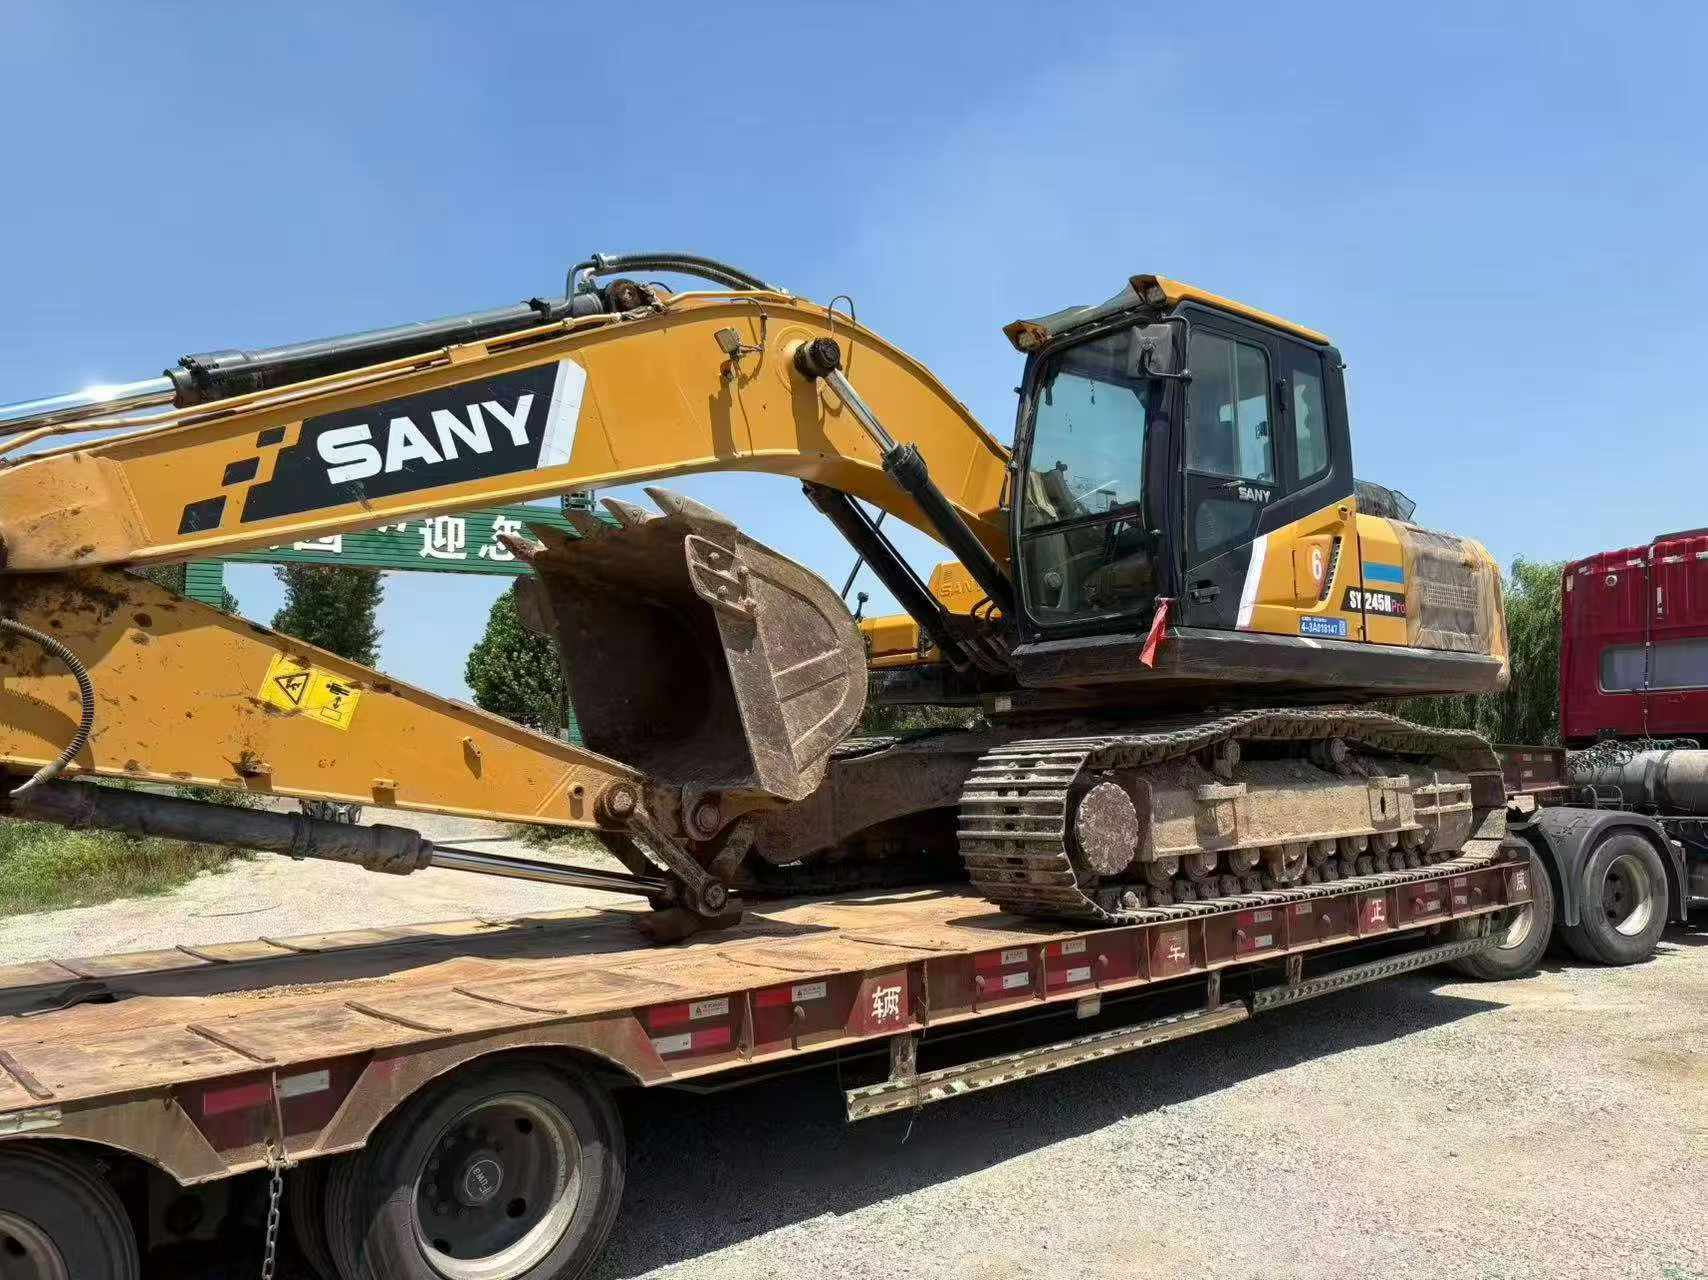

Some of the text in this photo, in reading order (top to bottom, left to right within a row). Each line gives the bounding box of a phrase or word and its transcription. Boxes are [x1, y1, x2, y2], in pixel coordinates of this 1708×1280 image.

[317, 394, 535, 485] SANY
[1238, 487, 1271, 503] SANY
[1312, 545, 1322, 580] 6
[1370, 899, 1385, 924] 正
[871, 986, 902, 1024] 辆
